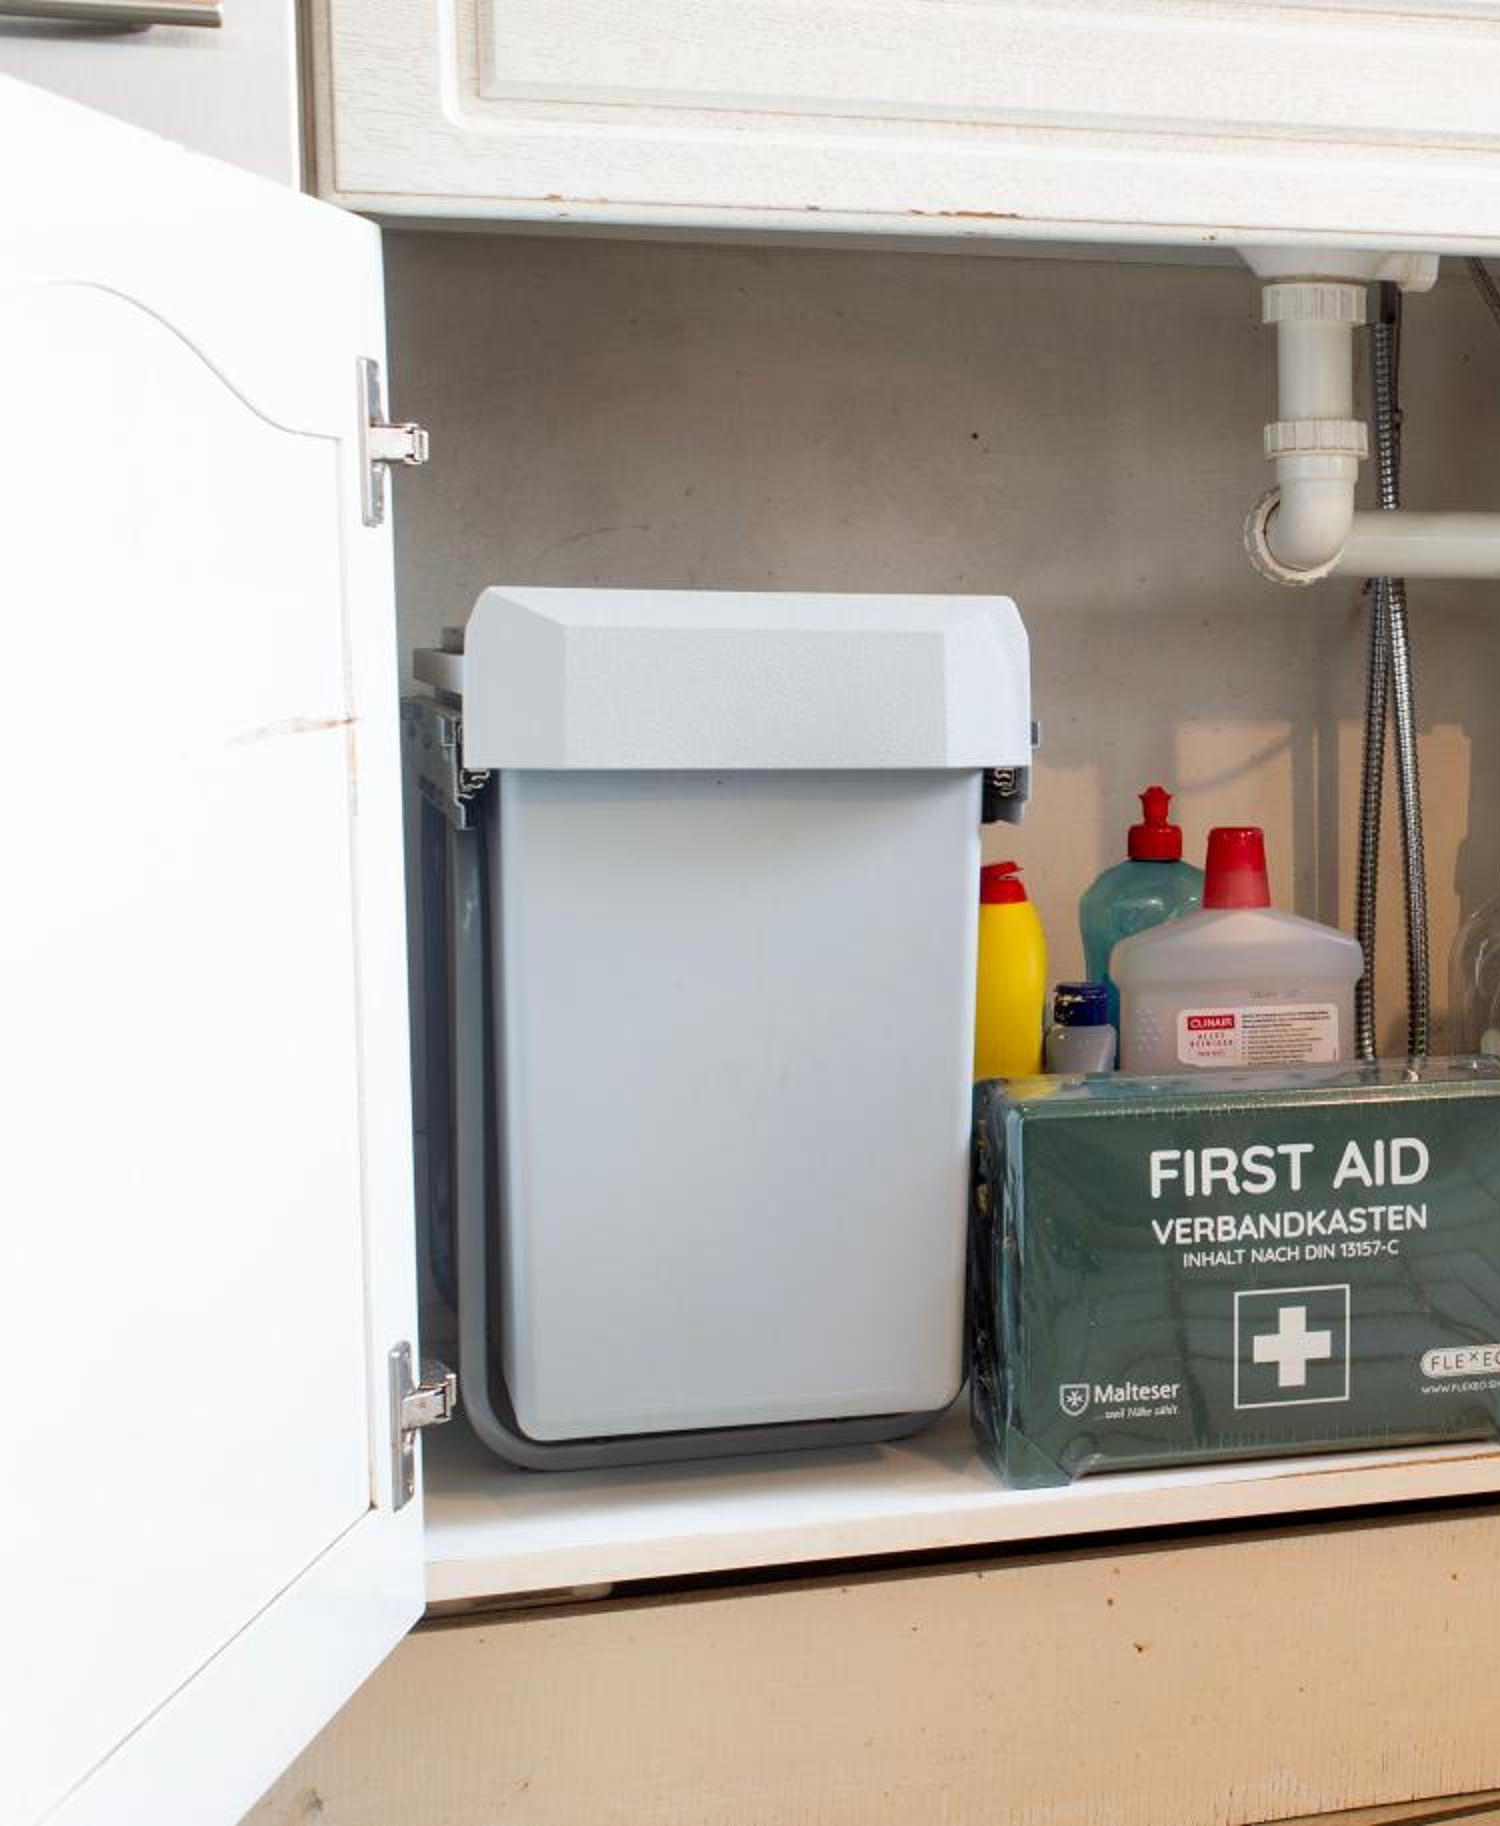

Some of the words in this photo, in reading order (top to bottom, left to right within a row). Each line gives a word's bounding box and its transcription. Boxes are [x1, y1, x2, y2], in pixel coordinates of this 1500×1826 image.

[1150, 1143, 1314, 1199] FIRST
[1334, 1138, 1429, 1189] AID
[1151, 1203, 1427, 1246] VERBANDKASTEN
[1183, 1248, 1245, 1269] INHALT
[1251, 1245, 1298, 1265] NACH
[1305, 1243, 1336, 1262] DIN
[1340, 1239, 1399, 1260] 13157-C
[1094, 1381, 1181, 1404] Malteser
